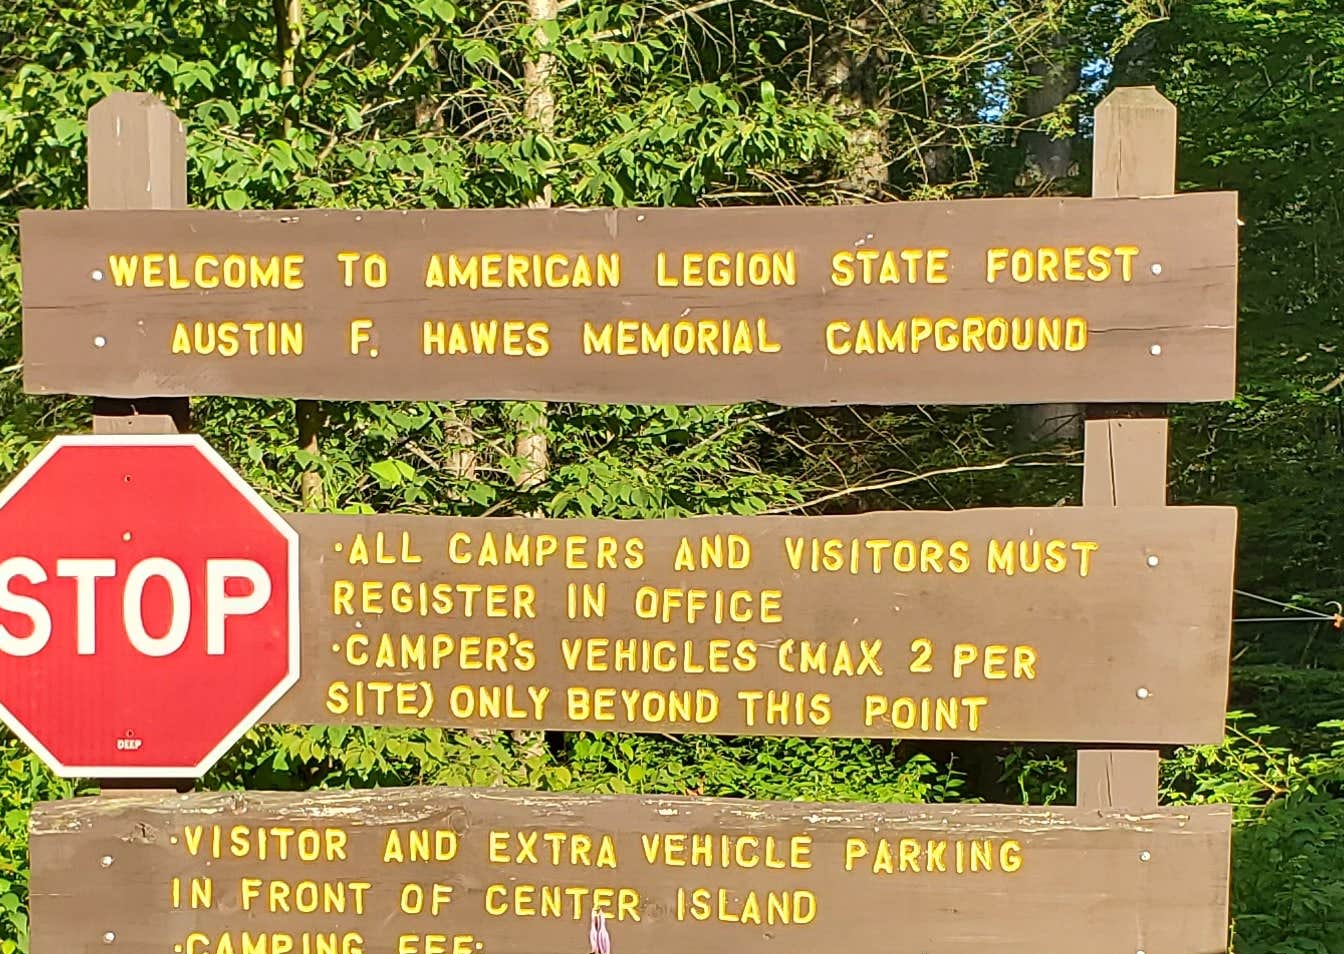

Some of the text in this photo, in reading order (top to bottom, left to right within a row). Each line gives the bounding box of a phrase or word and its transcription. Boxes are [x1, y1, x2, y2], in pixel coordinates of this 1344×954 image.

[109, 246, 1140, 290] WELCOME TO AMERICAN LEGION STATE FOREST
[171, 315, 1089, 358] AUSTIN F. HAWES MEMORIAL CAMPGROUND
[348, 531, 1100, 577] ALL CAMPERS AND VISITORS MUST
[332, 579, 784, 624] REGISTER IN OFFICE
[346, 631, 1038, 681] CAMPER'S VEHICLES (MAX 2 PER
[325, 680, 989, 732] SITE) ONLY BEYOND THIS POINT
[116, 738, 142, 750] DEEP
[183, 825, 1024, 875] VISITOR AND EXTRA VEHICLE PARKING
[171, 877, 818, 925] IN FRONT OF CENTER ISLAND
